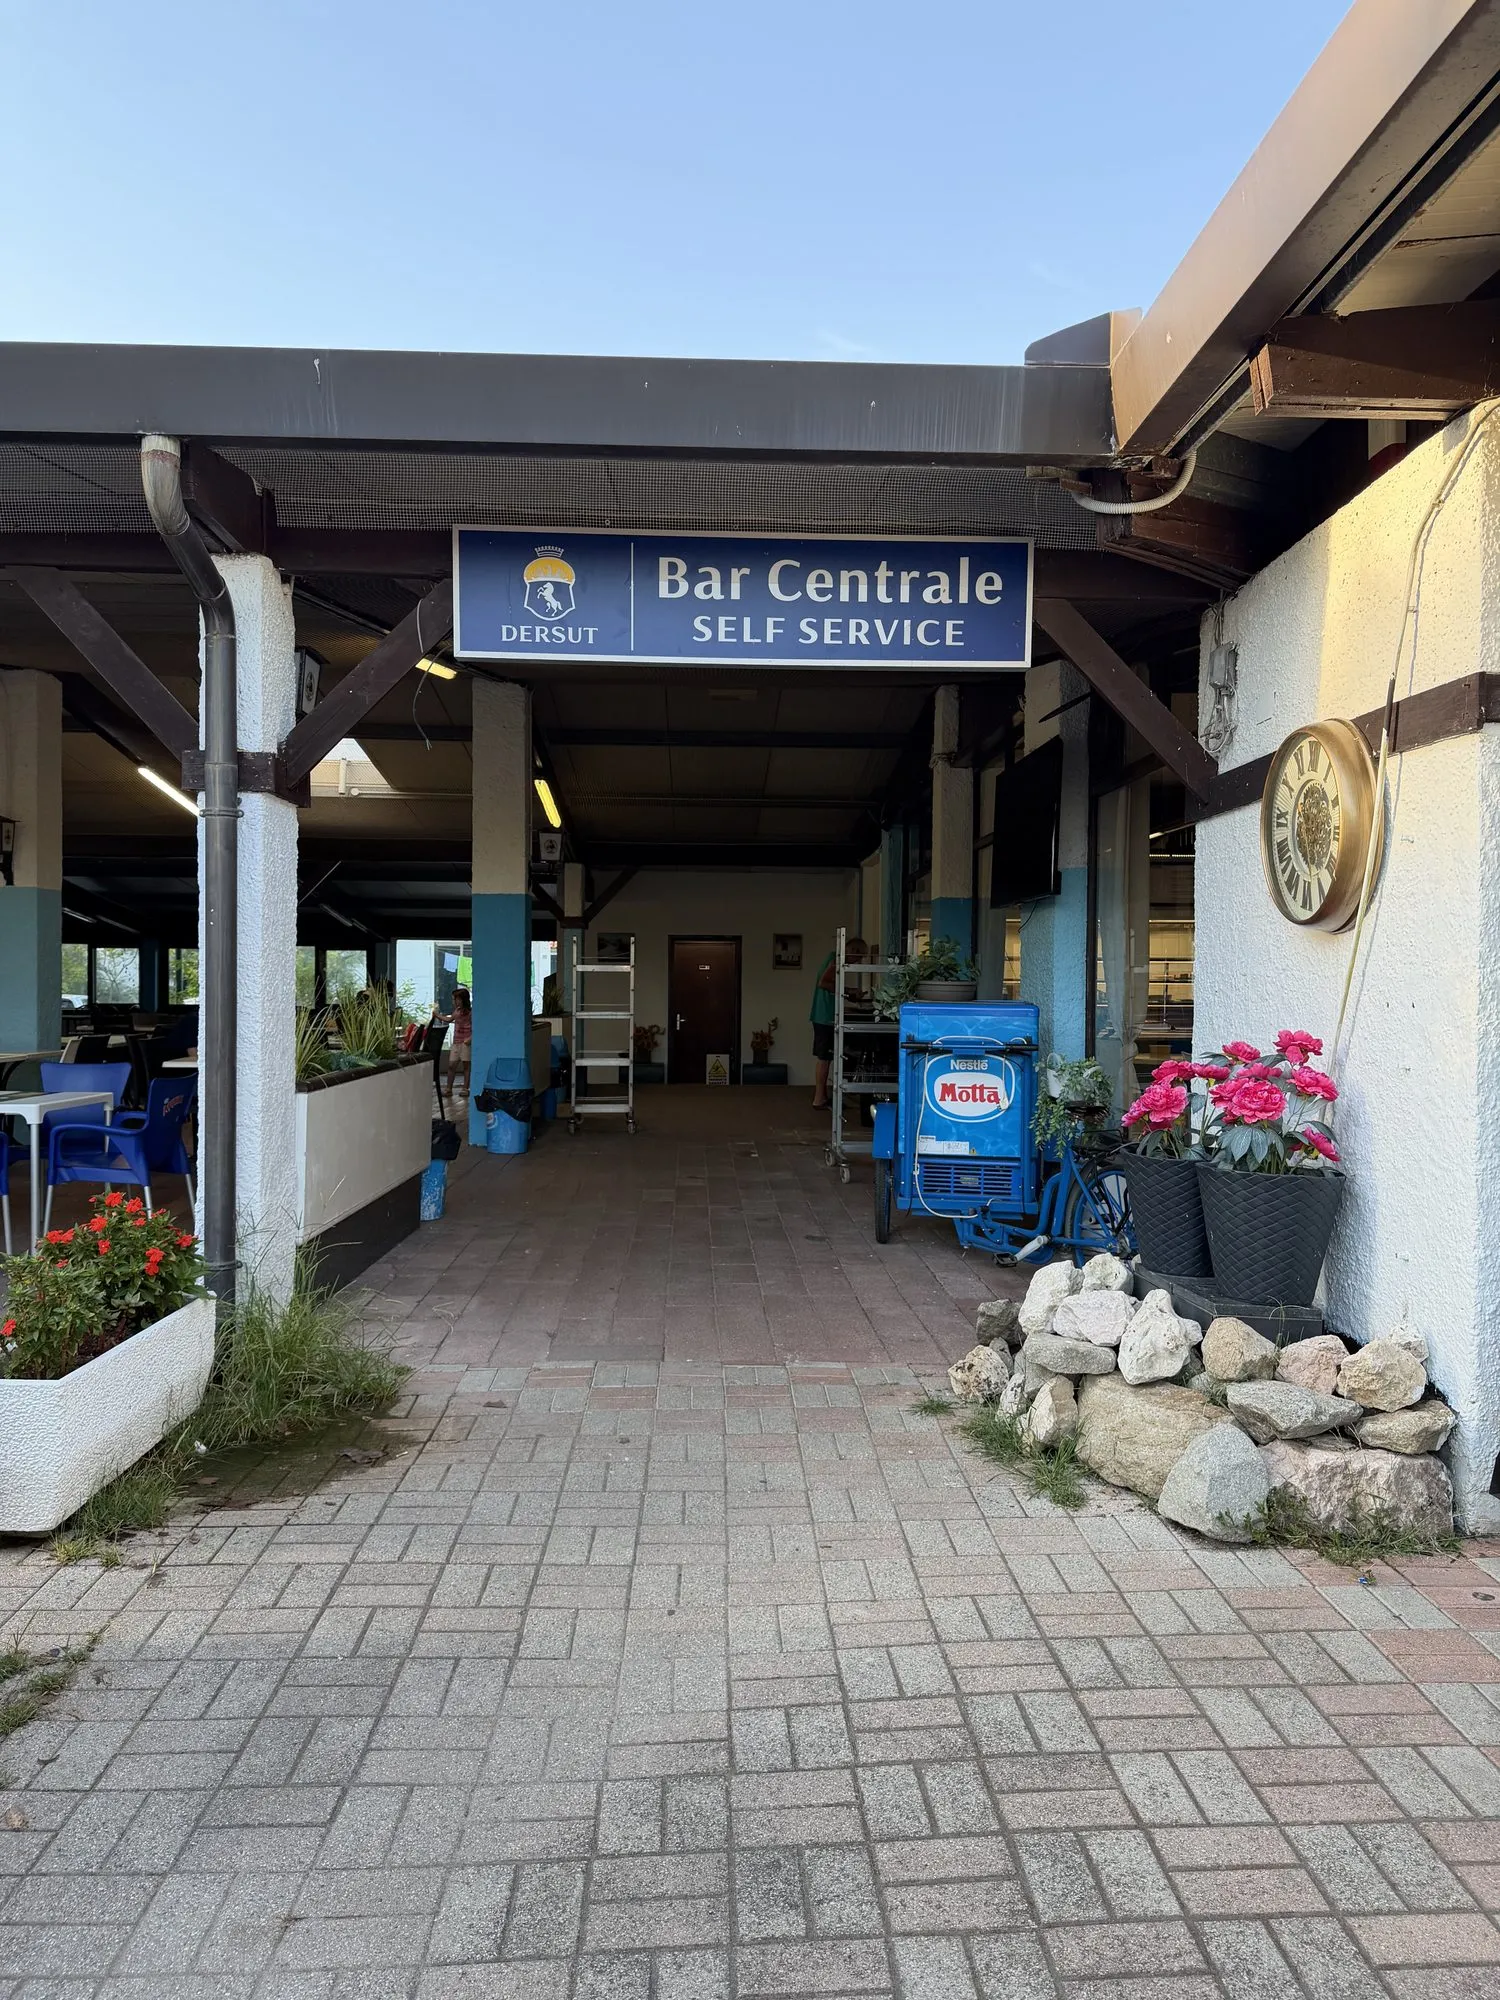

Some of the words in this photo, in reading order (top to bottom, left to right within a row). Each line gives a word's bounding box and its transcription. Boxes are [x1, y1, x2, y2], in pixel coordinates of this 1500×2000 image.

[658, 557, 751, 601] Bar
[768, 557, 1003, 605] Centrale
[501, 624, 598, 644] DERSUT
[692, 615, 786, 644] SELF
[798, 617, 966, 647] SERVICE
[939, 1083, 1001, 1104] Motta
